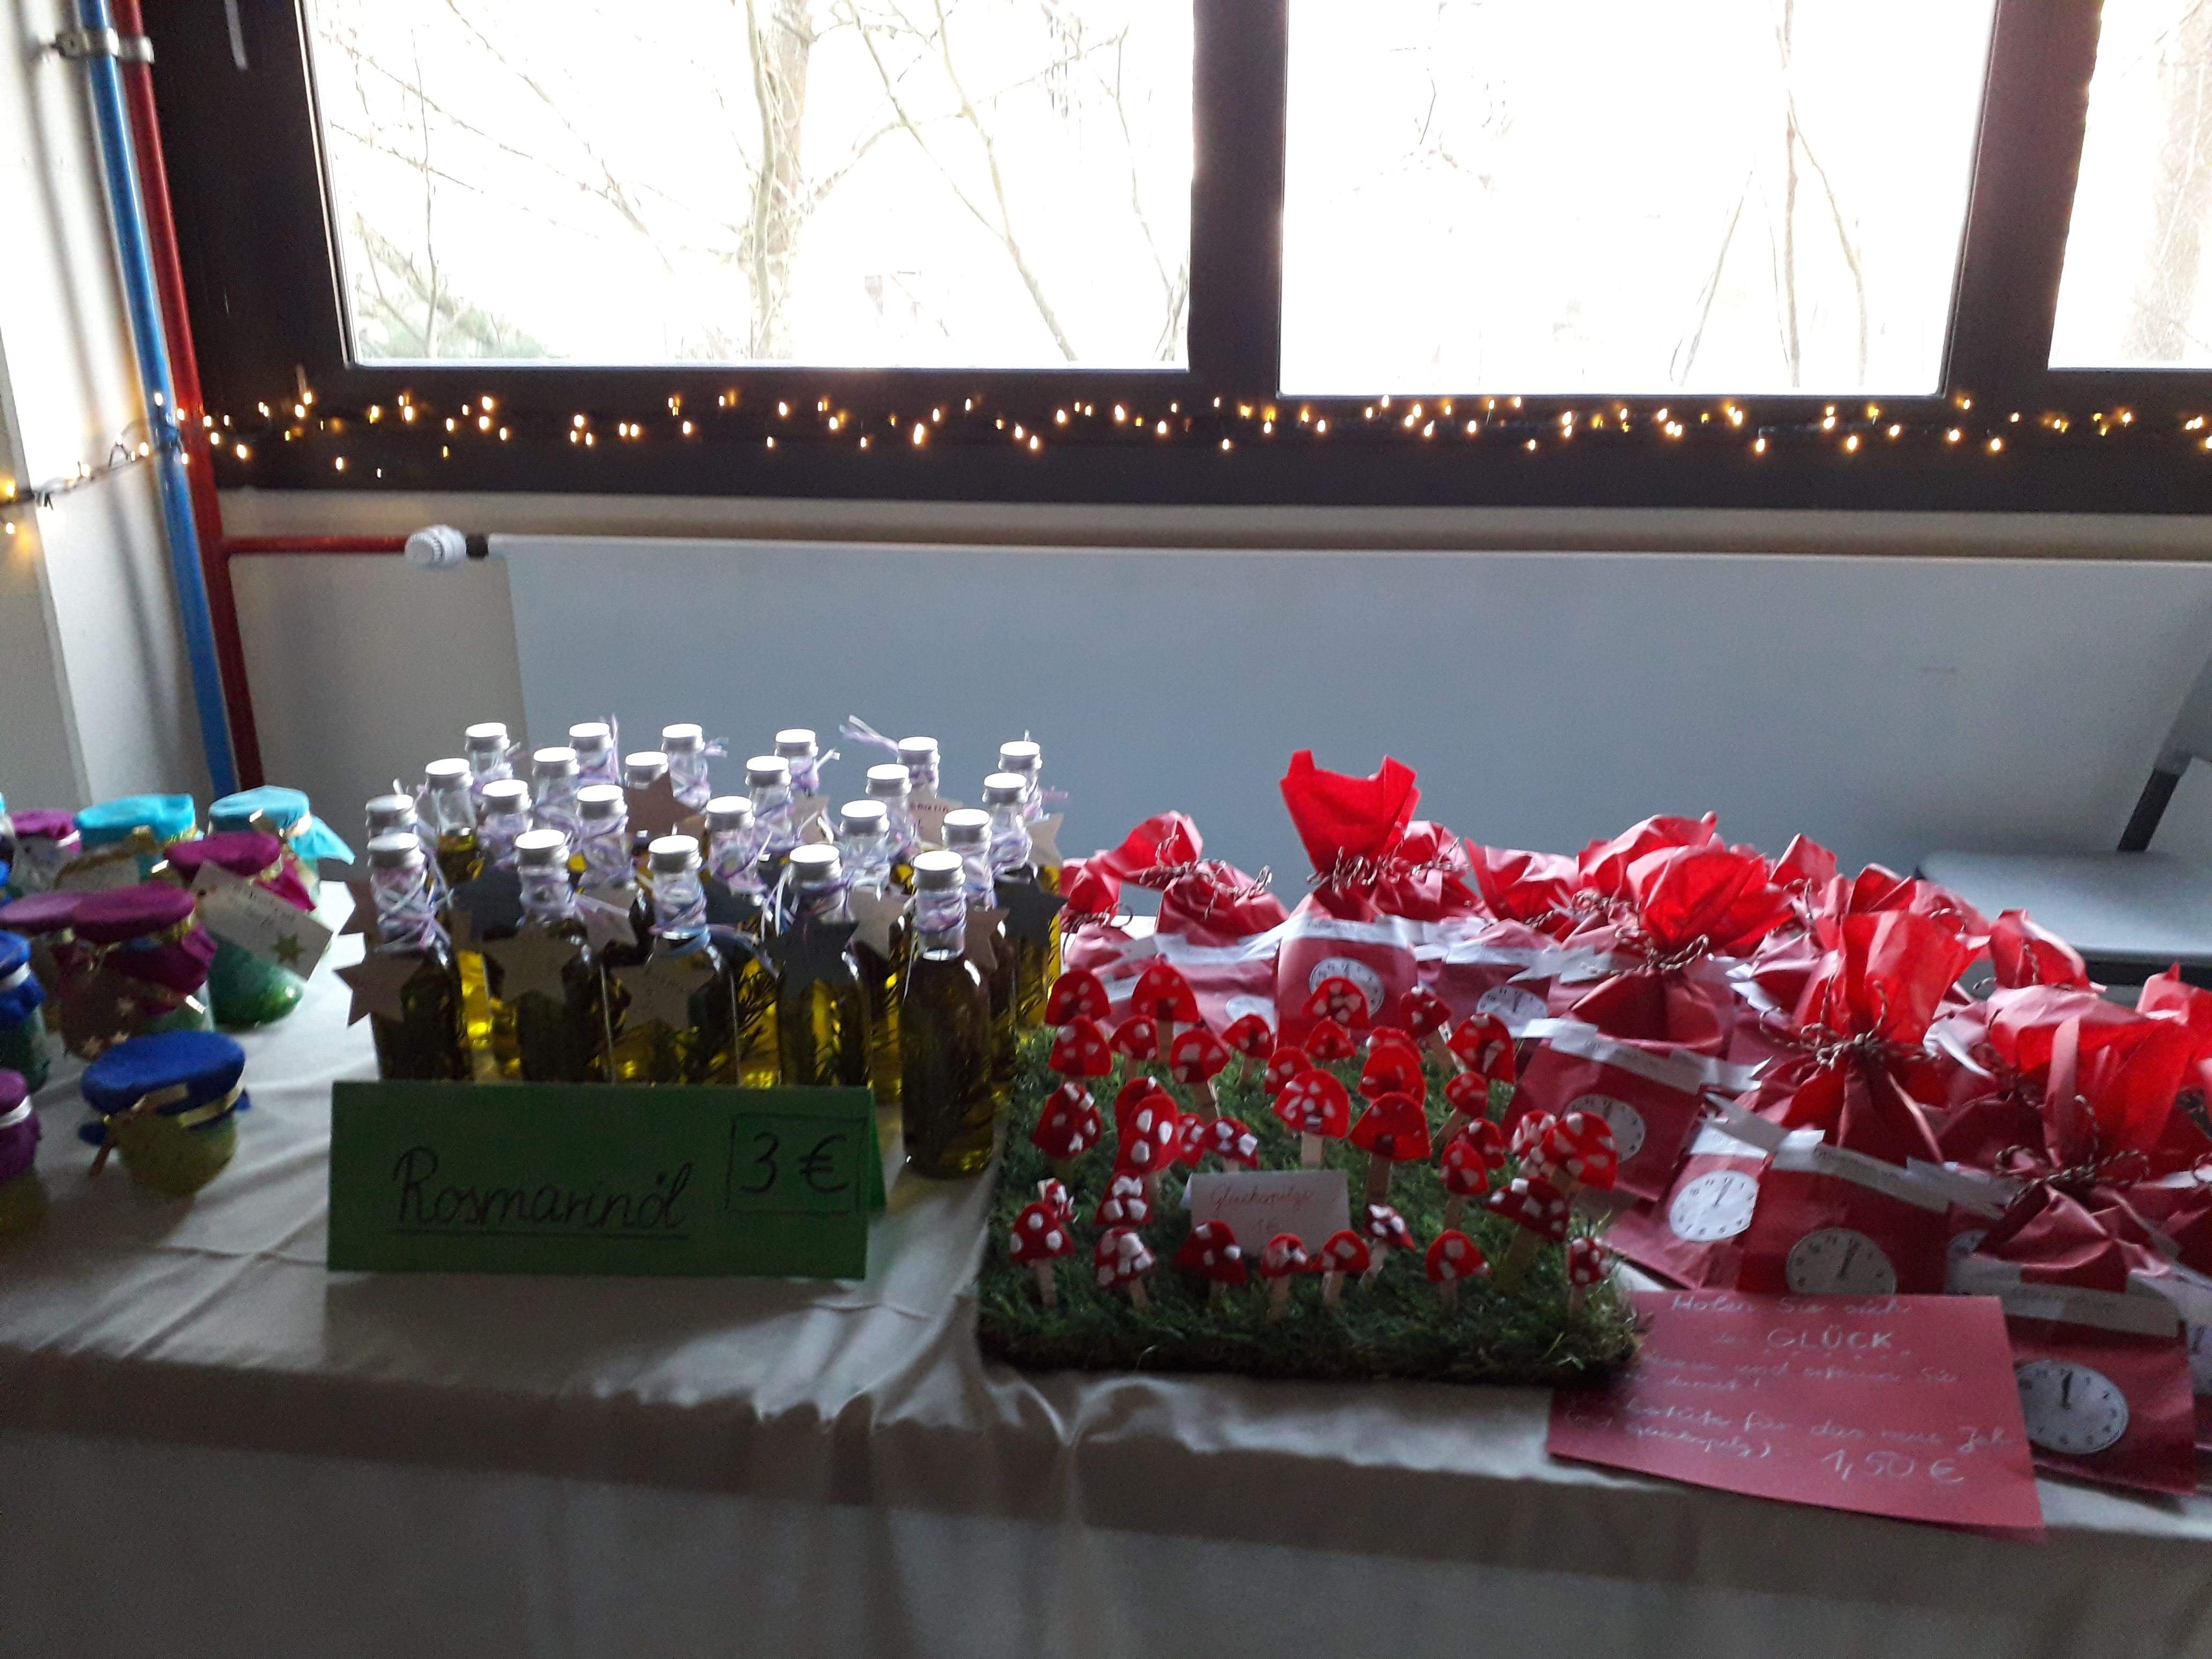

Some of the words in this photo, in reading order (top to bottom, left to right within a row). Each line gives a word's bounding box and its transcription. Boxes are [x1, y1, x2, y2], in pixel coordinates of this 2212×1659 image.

[741, 1132, 779, 1194] 3
[799, 1134, 848, 1193] €
[392, 1146, 692, 1230] Rosmarinöl
[1767, 1325, 1895, 1349] GLÜCK
[1930, 1458, 1966, 1483] €
